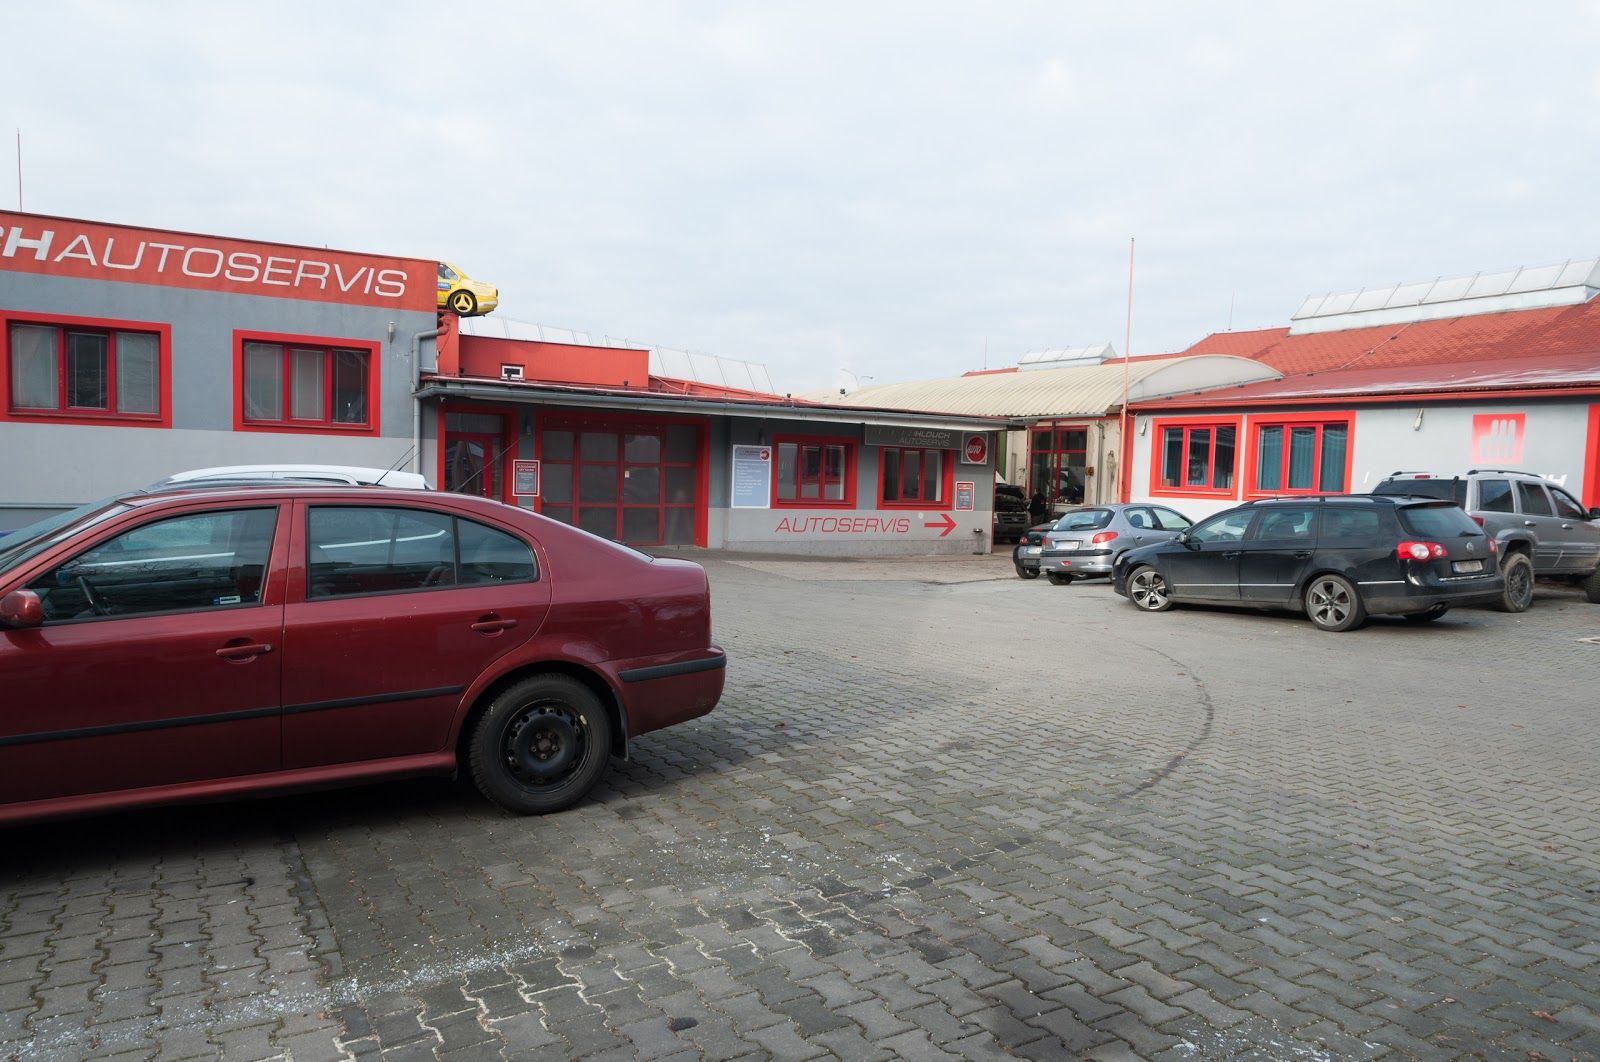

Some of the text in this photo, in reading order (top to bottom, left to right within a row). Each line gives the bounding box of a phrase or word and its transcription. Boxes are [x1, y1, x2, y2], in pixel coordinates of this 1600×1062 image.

[54, 234, 408, 298] AUTOSERVIS
[899, 437, 951, 447] AUTOSERVIS
[775, 517, 910, 533] AUTOSERVIS
